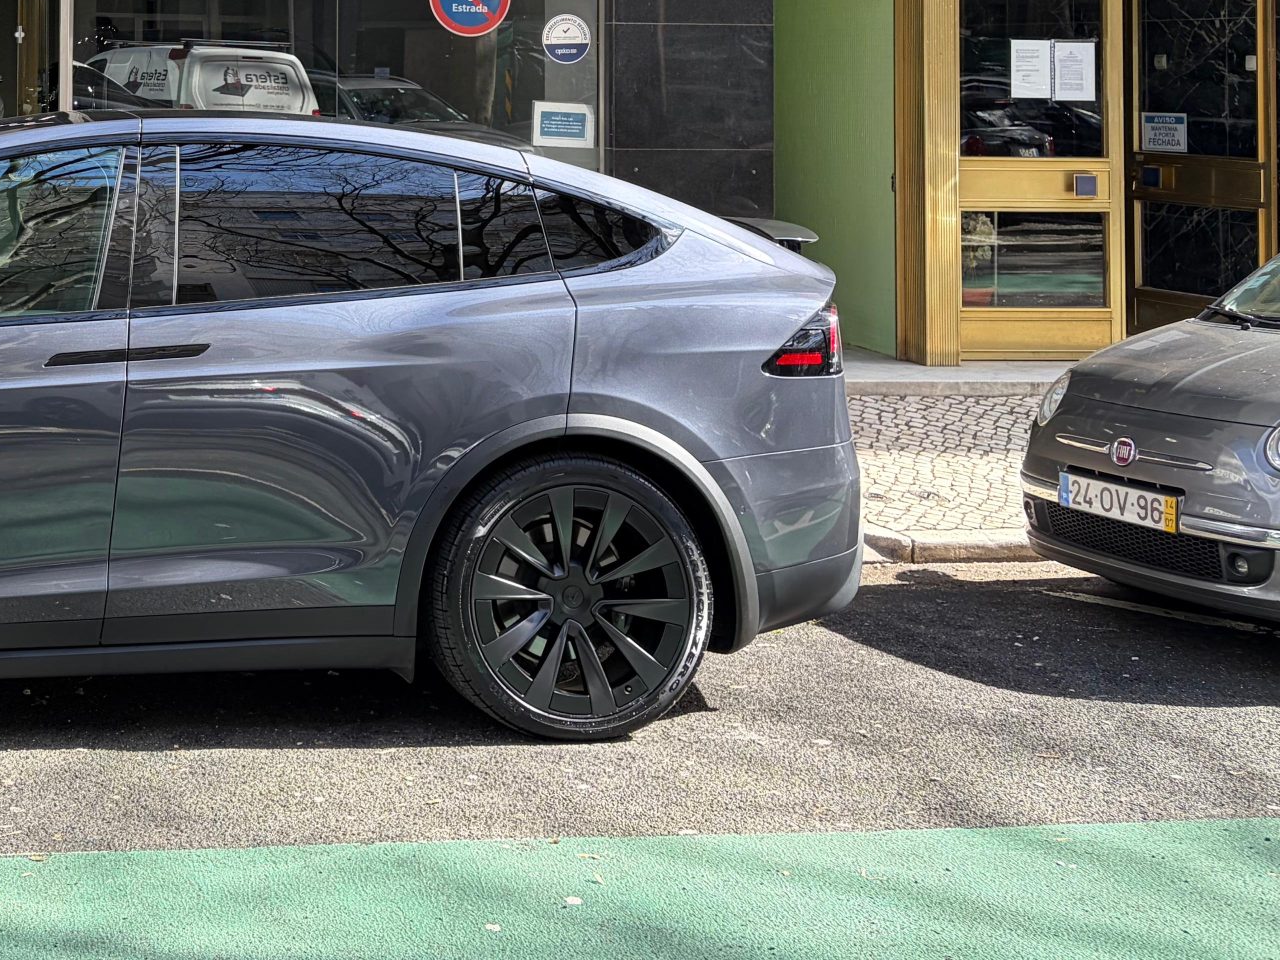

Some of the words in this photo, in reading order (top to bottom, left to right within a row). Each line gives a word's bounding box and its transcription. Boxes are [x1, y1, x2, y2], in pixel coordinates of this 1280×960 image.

[452, 3, 488, 13] Estrada
[1153, 116, 1176, 124] AVISO
[1148, 138, 1182, 147] FECHADA
